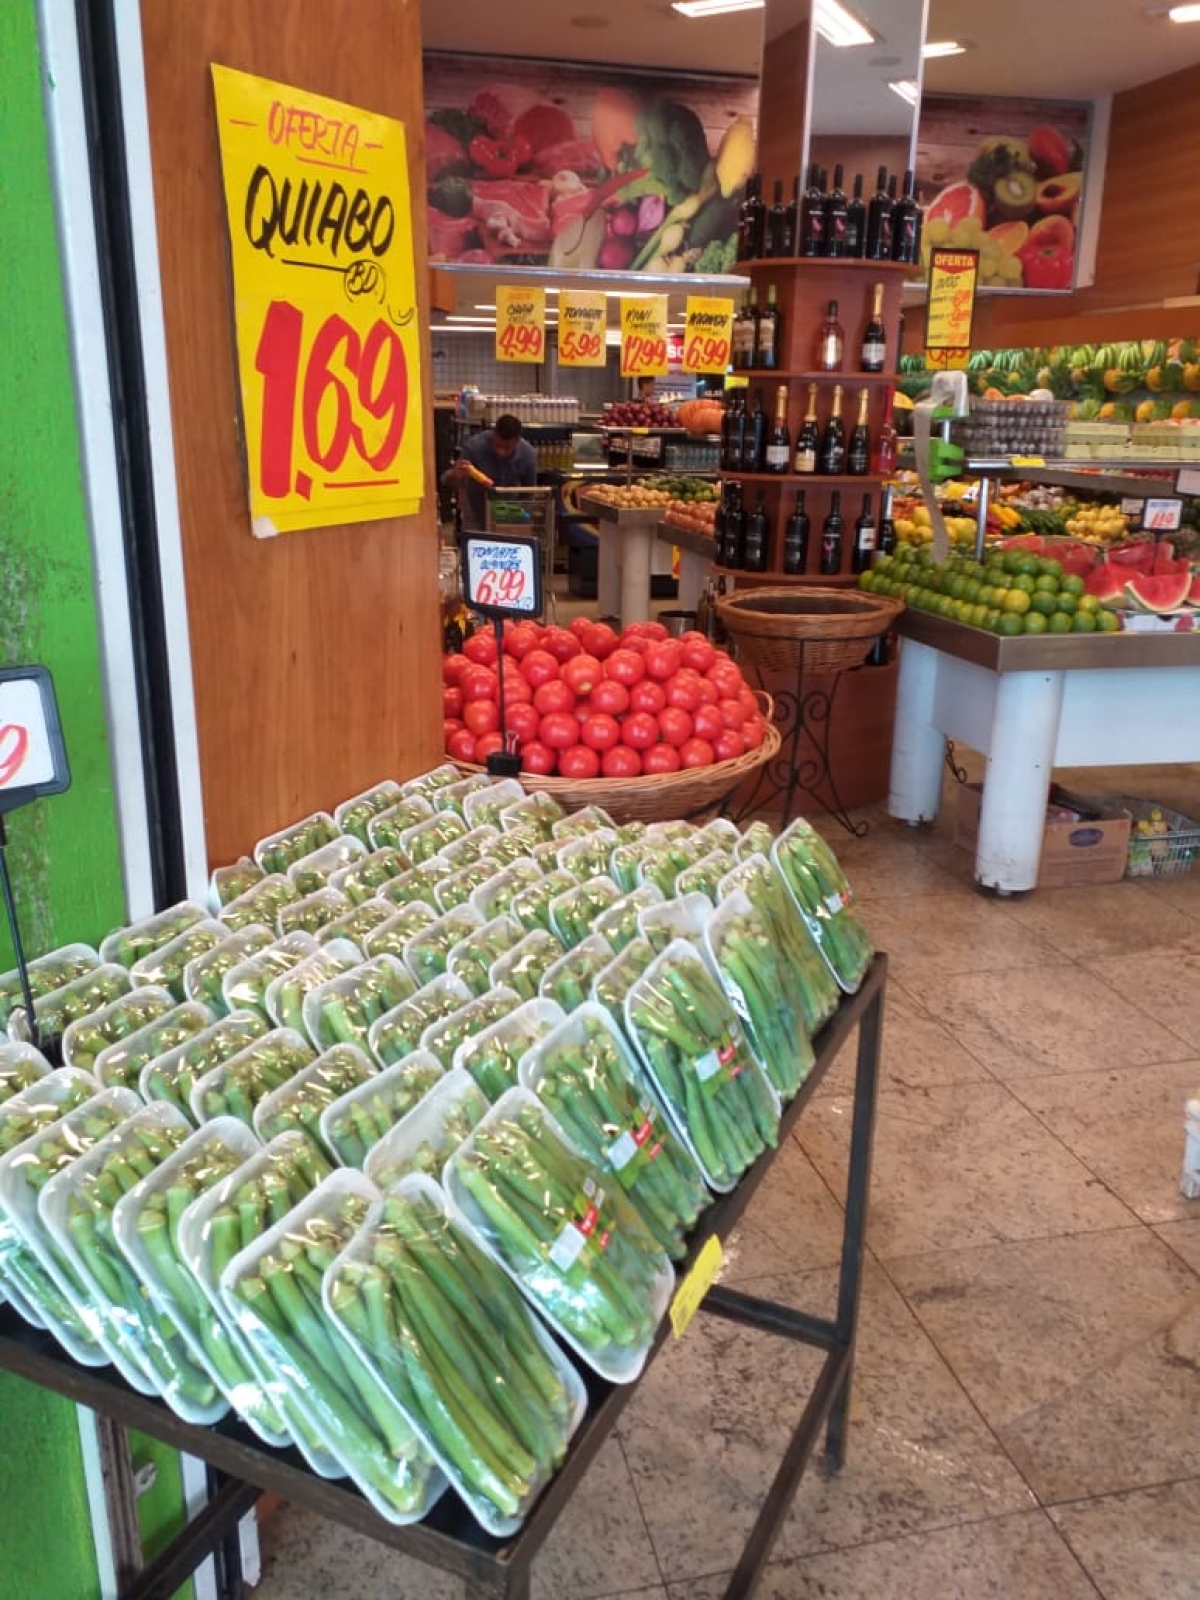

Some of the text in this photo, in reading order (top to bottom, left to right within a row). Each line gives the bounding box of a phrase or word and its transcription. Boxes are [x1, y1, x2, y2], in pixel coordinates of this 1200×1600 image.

[268, 102, 359, 169] OFERTA
[244, 165, 395, 258] QUIABO
[934, 254, 975, 266] OFERTA
[472, 546, 522, 559] TOMATE
